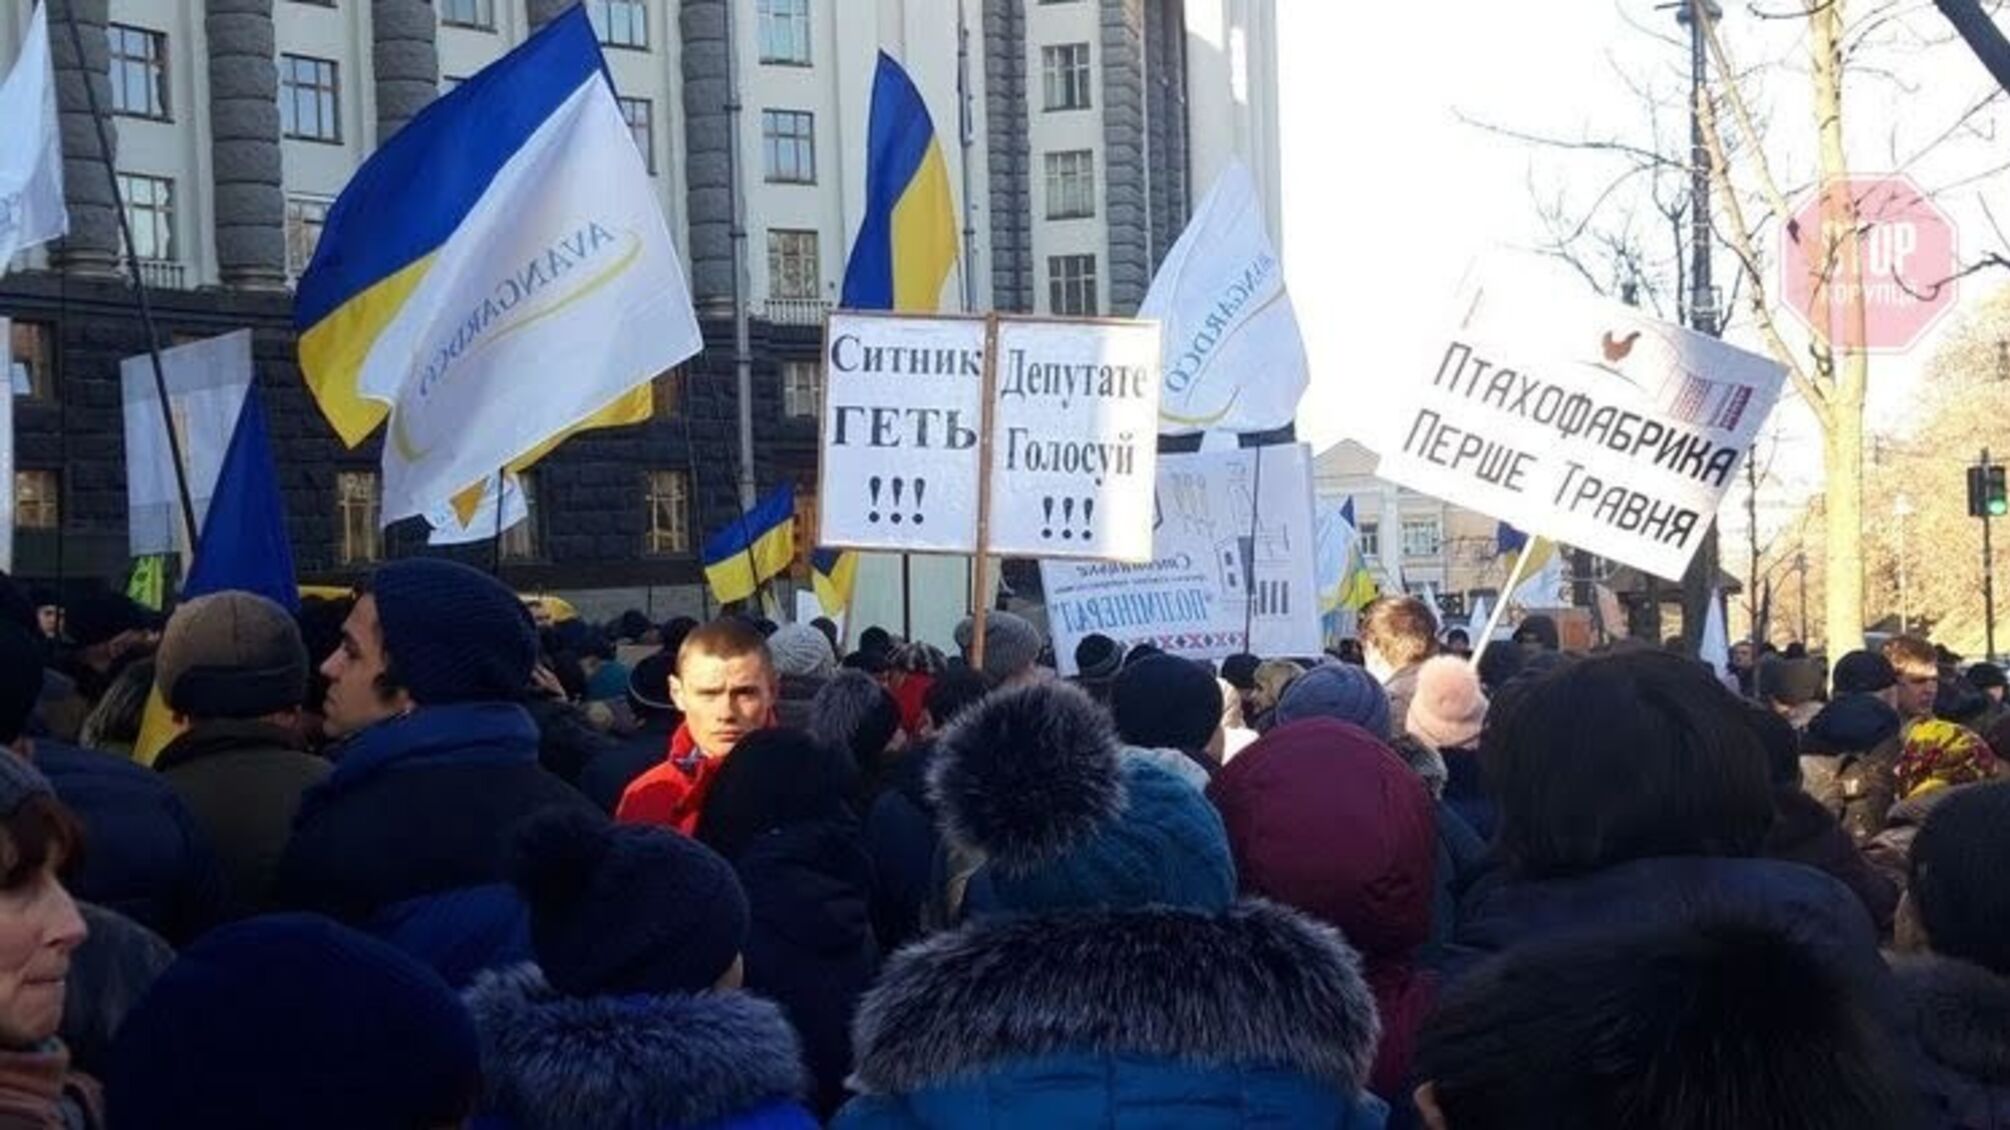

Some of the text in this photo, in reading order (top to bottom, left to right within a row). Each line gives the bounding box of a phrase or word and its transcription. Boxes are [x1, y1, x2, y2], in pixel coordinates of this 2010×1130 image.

[831, 334, 983, 377] Ситник
[1001, 349, 1149, 409] Депутате
[830, 406, 978, 450] ГЕТЬ
[1433, 341, 1740, 488] ПТАХОФАБРИКА
[1005, 427, 1134, 487] Голосуй
[1402, 408, 1701, 549] ПЕРШЕ ТРАВНЯ
[868, 476, 926, 525] !!!
[1041, 497, 1095, 541] !!!
